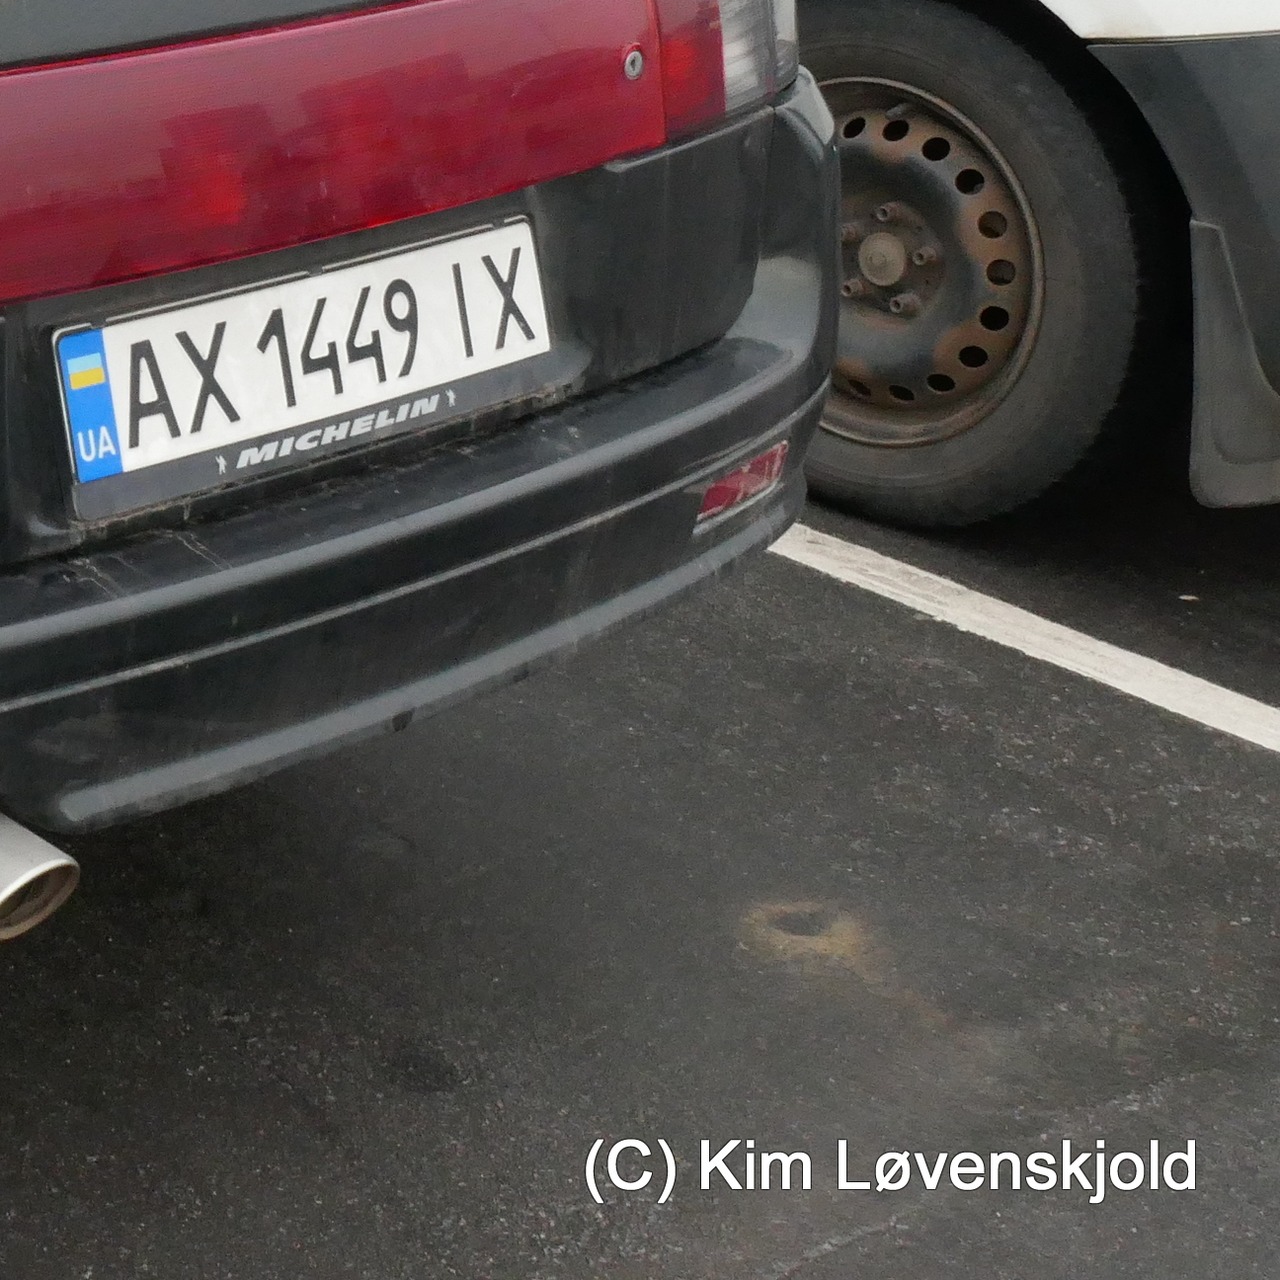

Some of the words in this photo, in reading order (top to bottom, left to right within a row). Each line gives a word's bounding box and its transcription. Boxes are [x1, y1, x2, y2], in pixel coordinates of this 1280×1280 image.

[127, 321, 241, 449] AX
[256, 278, 419, 408] 1449
[452, 247, 535, 358] IX
[77, 426, 117, 463] UA
[236, 393, 440, 469] MICHELIN
